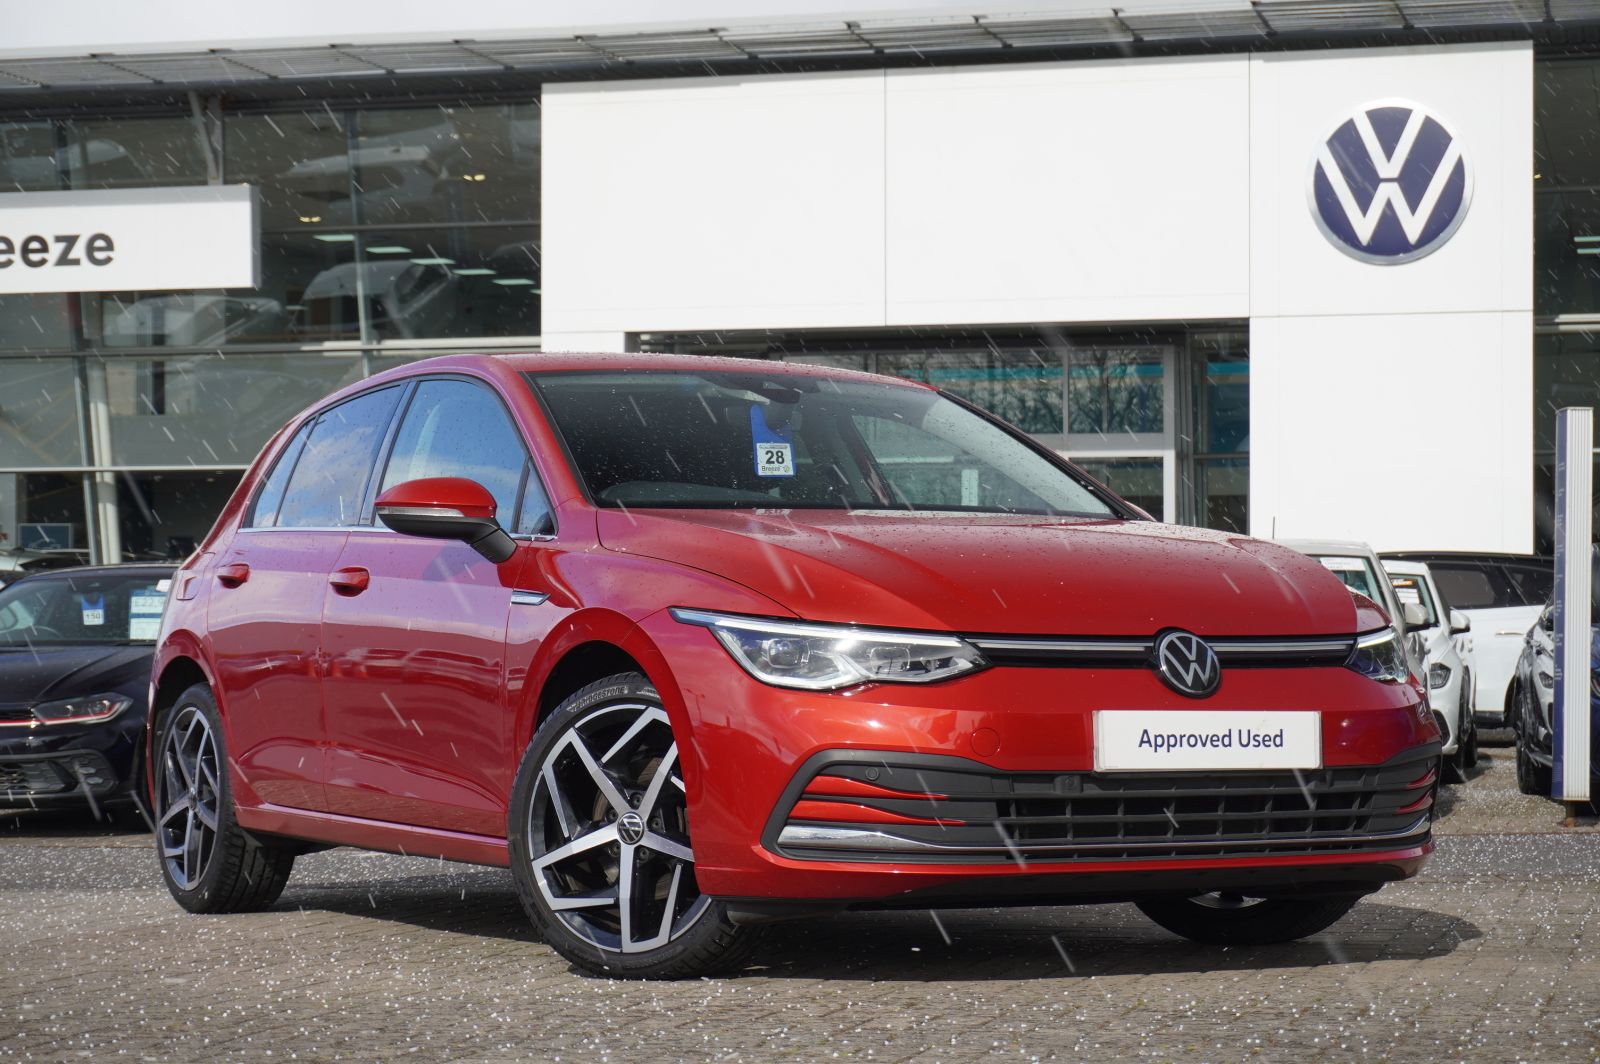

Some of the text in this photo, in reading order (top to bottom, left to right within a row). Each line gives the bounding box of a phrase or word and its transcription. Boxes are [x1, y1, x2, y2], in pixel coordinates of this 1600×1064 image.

[765, 450, 785, 465] 28
[1138, 728, 1284, 753] Approved Used
